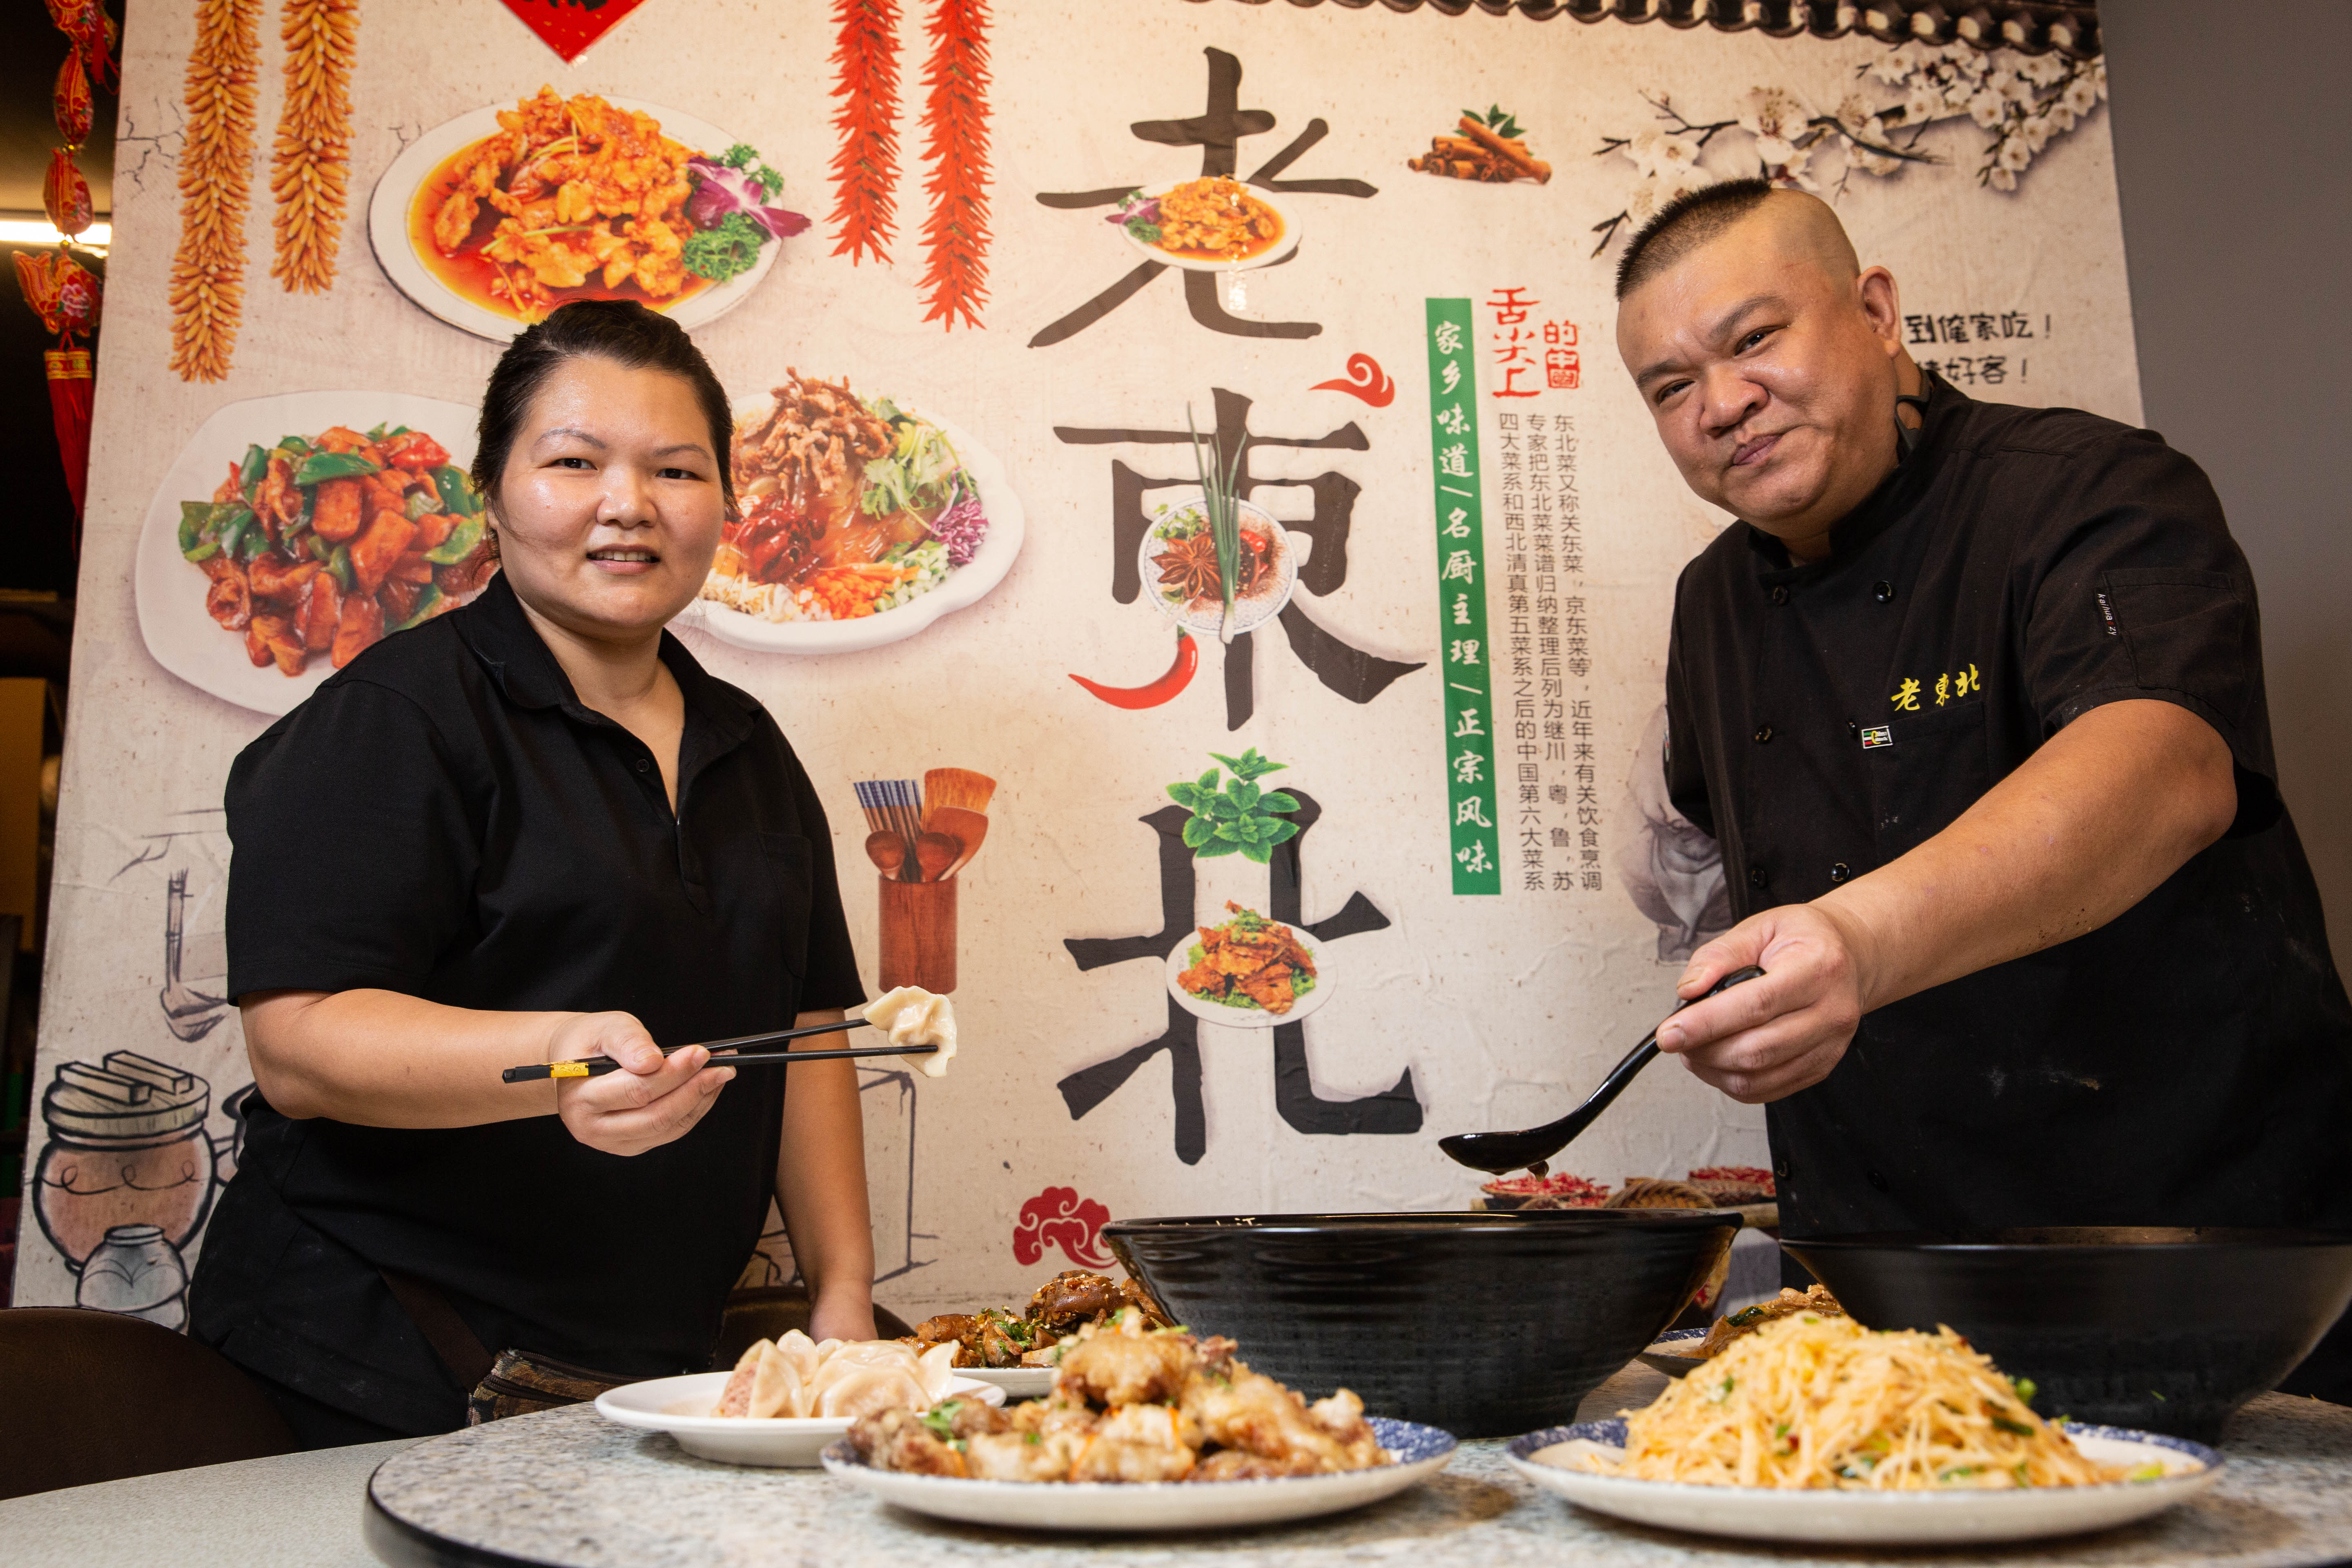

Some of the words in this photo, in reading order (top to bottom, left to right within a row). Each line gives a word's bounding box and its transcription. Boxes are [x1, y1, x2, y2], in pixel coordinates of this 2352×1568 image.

[1486, 287, 1541, 397] 舌尖上
[1891, 664, 1980, 711] 老東北
